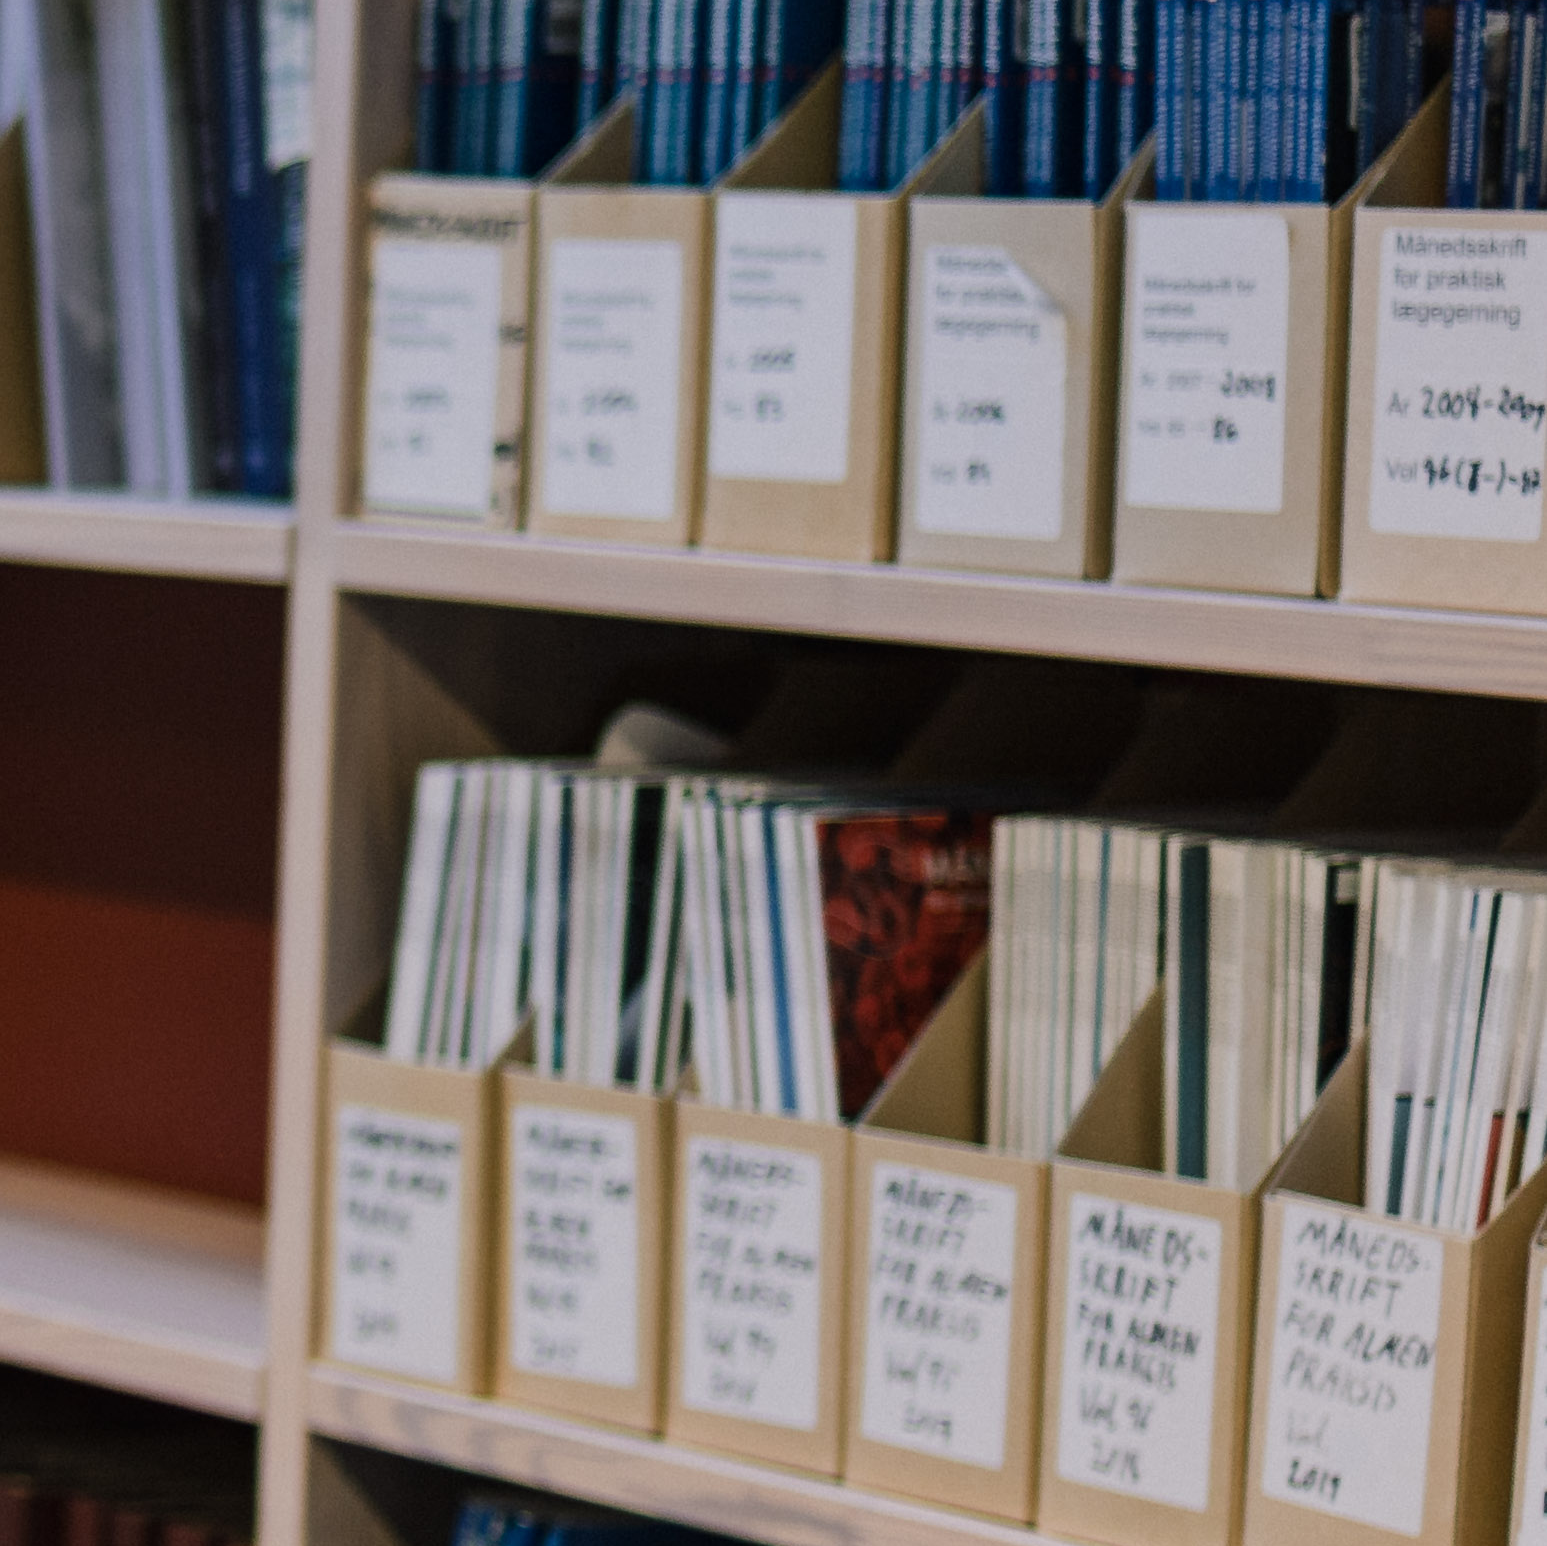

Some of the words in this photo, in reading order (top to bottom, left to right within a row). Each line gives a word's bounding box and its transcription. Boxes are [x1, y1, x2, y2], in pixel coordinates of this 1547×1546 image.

[1395, 232, 1527, 258] Månedsskrift
[1393, 267, 1418, 289] for
[1426, 267, 1506, 291] praktisk
[1392, 299, 1522, 331] lægegerning
[1385, 455, 1418, 483] Vol
[1078, 1254, 1179, 1314] SKRIFT
[1294, 1259, 1402, 1320] SKRIFT
[1076, 1301, 1116, 1339] FOR
[1126, 1317, 1201, 1357] ALMEN
[1283, 1300, 1336, 1348] FOR
[1342, 1322, 1436, 1370] ALMEN
[1081, 1337, 1177, 1393] PRAKSIS
[1283, 1346, 1397, 1413] PRAKSIS
[1286, 1456, 1342, 1503] 2019
